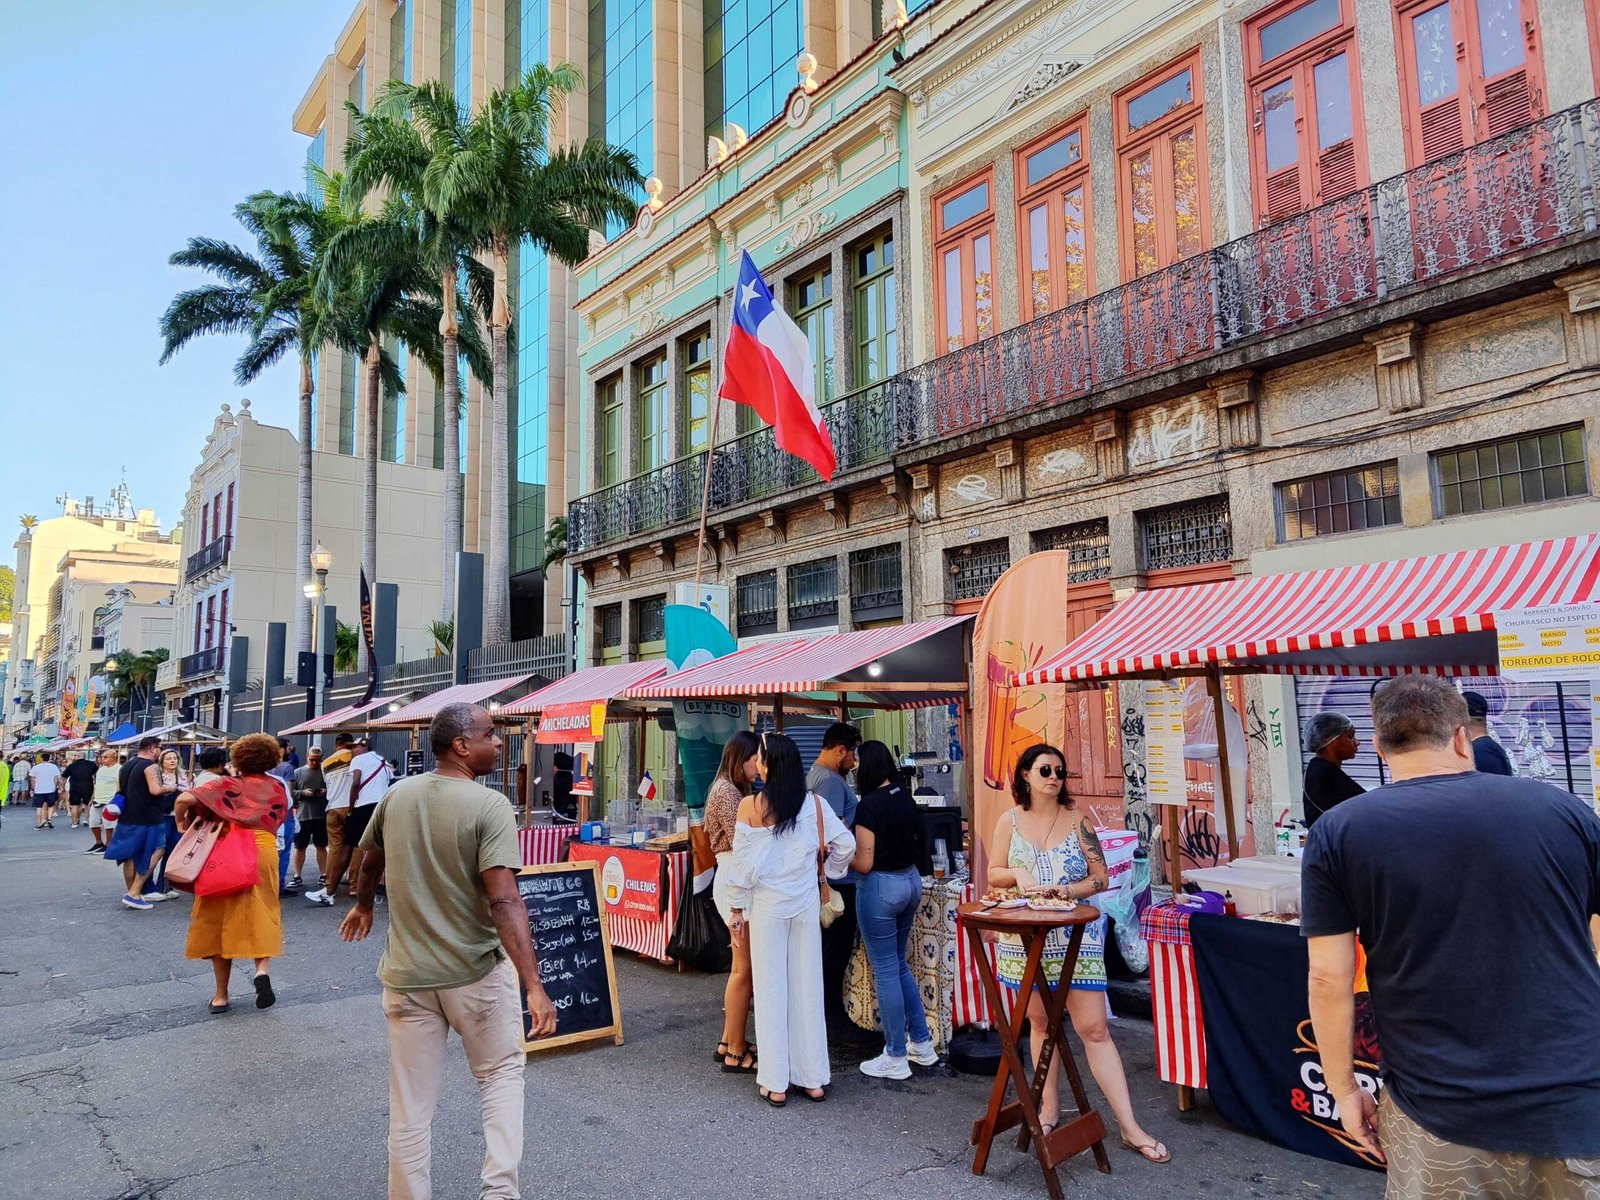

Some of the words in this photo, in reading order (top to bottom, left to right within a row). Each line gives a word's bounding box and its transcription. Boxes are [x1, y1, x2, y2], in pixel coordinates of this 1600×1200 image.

[1524, 607, 1556, 616] BARBANTE
[1564, 604, 1592, 612] CARVÃO
[1505, 617, 1551, 628] CHURRASCO
[1553, 616, 1566, 624] NO
[1567, 613, 1597, 622] ESPETO
[1501, 656, 1553, 667] TORREMO
[1555, 655, 1569, 664] DE
[1572, 653, 1600, 663] ROLO
[541, 714, 590, 732] MICHELADAS
